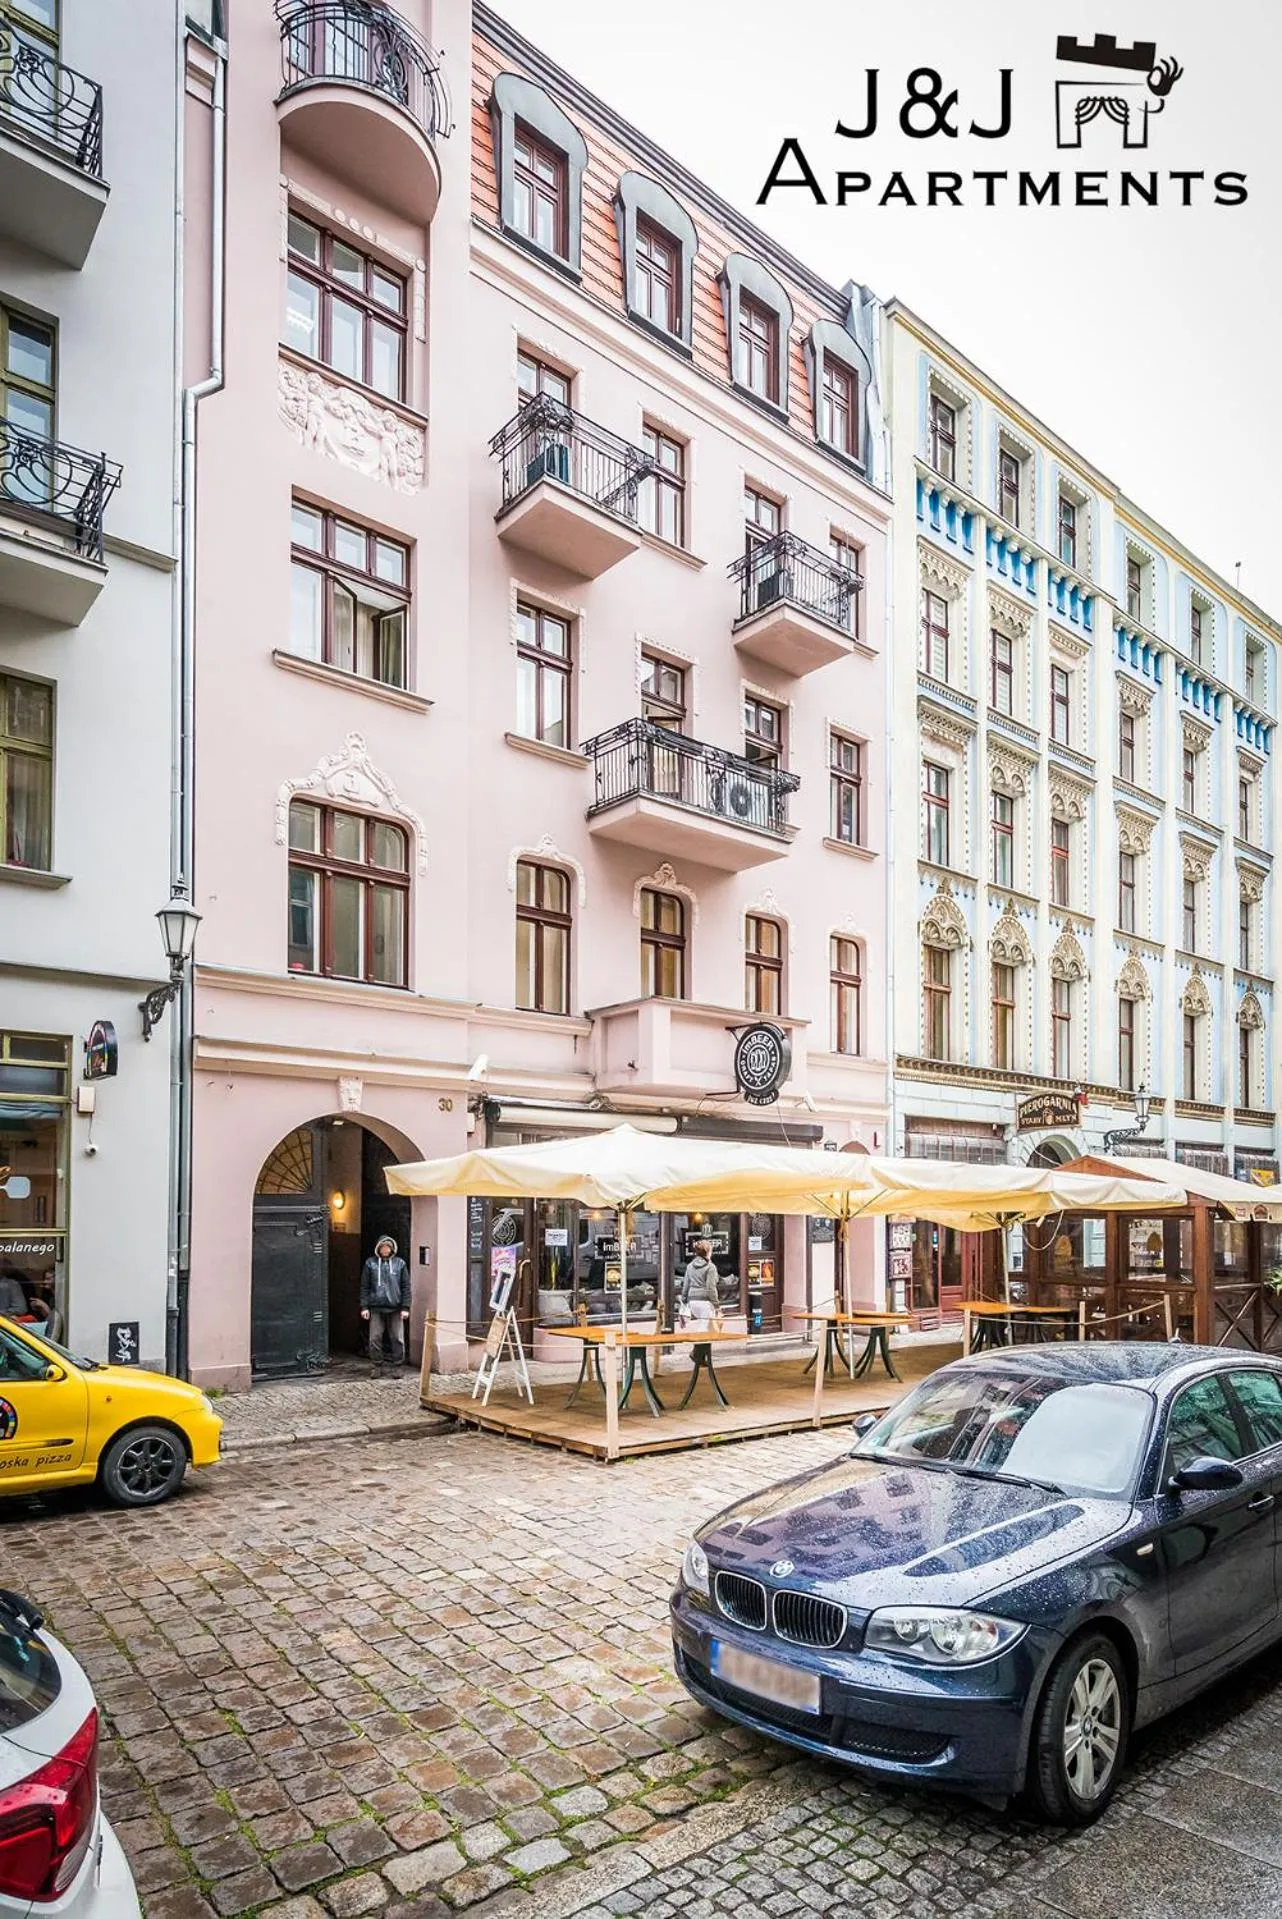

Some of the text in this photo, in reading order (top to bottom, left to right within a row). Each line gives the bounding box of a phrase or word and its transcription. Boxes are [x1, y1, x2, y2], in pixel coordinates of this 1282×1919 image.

[438, 1097, 453, 1112] 30
[1020, 1095, 1078, 1118] PIEROGARNIA
[35, 1453, 72, 1468] pizza
